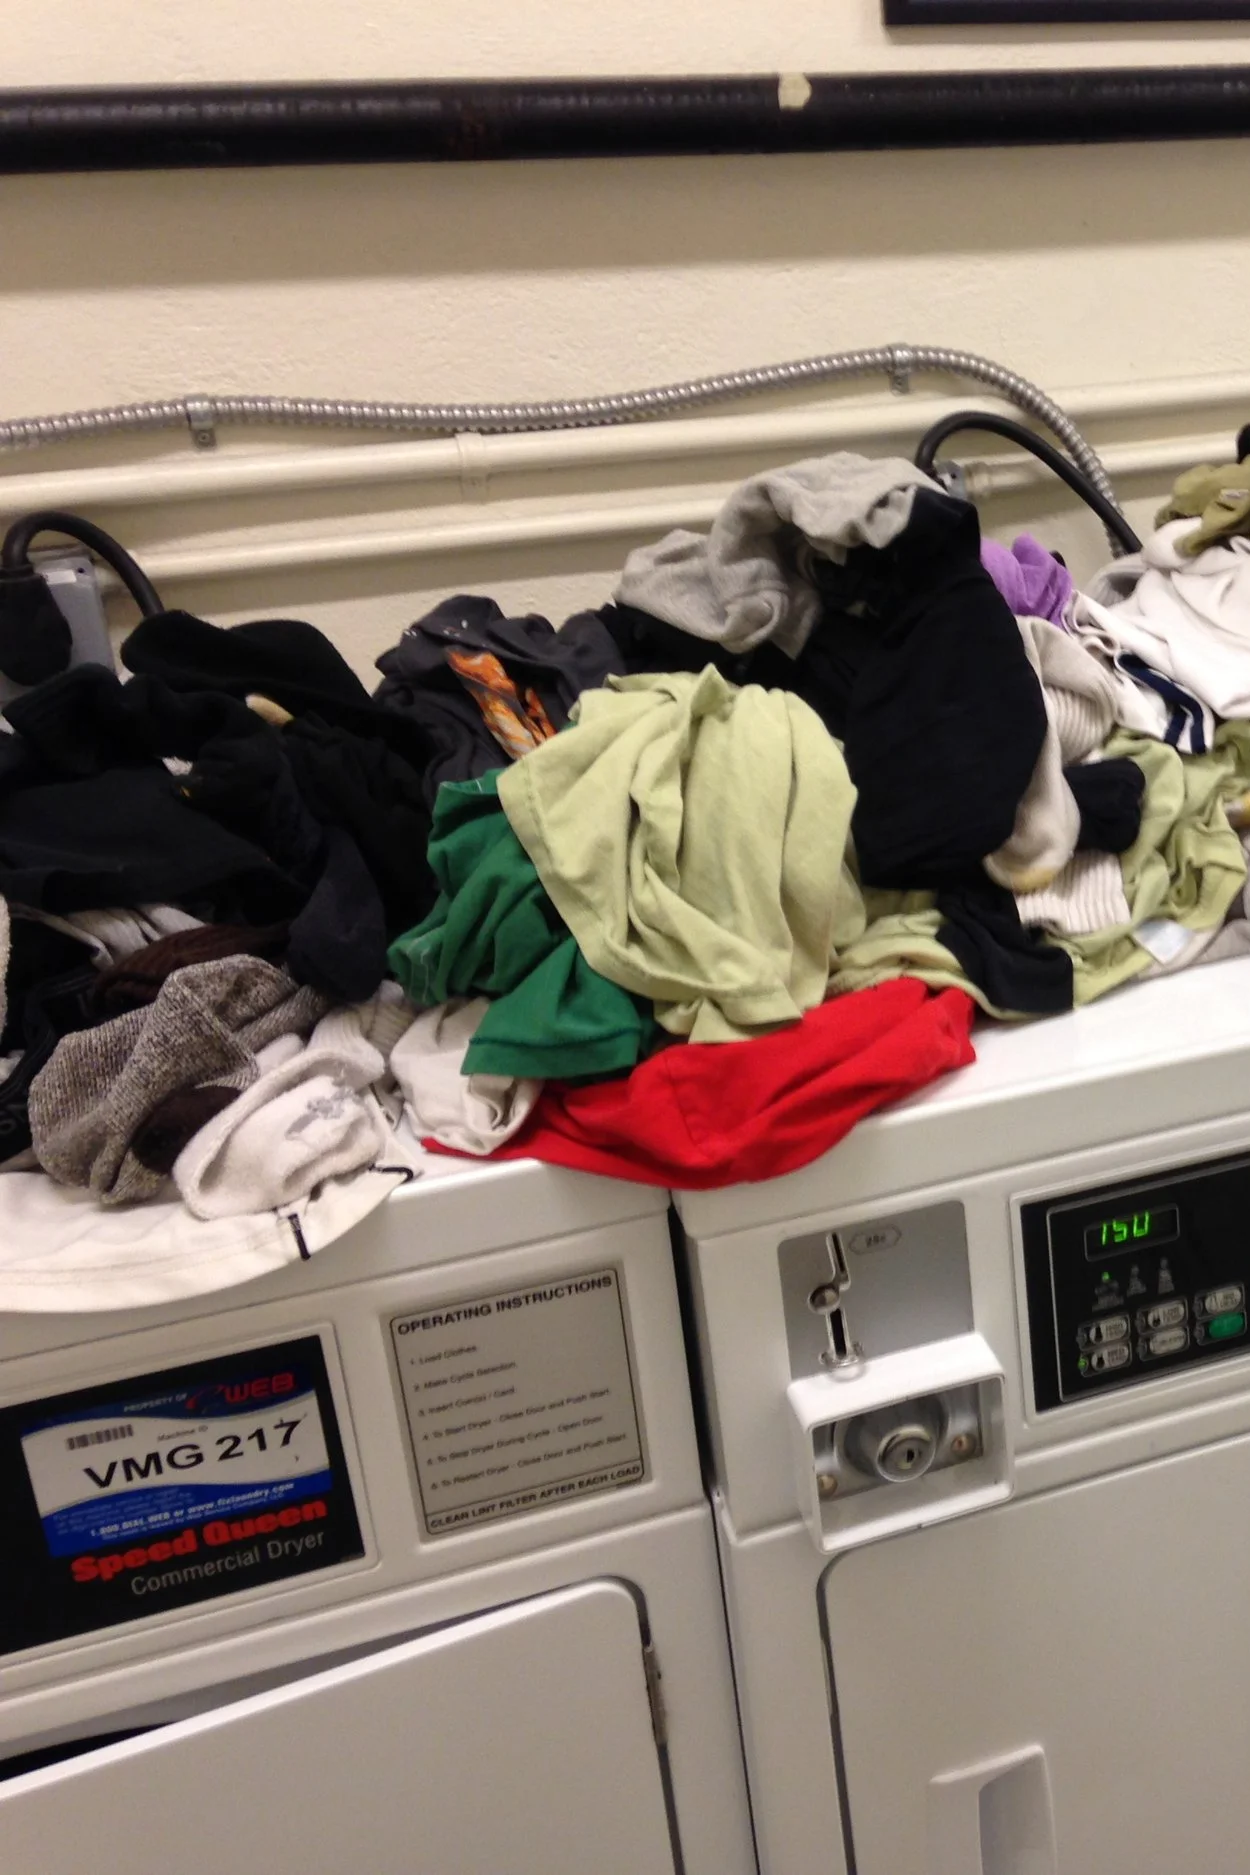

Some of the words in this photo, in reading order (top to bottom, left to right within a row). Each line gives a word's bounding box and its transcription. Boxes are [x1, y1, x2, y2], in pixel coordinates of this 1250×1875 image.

[397, 1303, 492, 1335] OPERATING
[496, 1275, 612, 1312] INSTRUCTIONS
[223, 1372, 295, 1404] WEB
[84, 1444, 205, 1489] VMG
[215, 1419, 302, 1462] 217
[429, 1509, 470, 1529] CLEAN
[471, 1502, 497, 1518] LINT
[498, 1493, 537, 1511] FILTER
[538, 1482, 576, 1500] AFTER
[577, 1473, 609, 1490] EACH
[610, 1465, 641, 1481] LOAD
[70, 1528, 197, 1583] Speed
[202, 1500, 328, 1546] Queen
[130, 1546, 260, 1596] Commercial
[266, 1531, 325, 1560] Dryer
